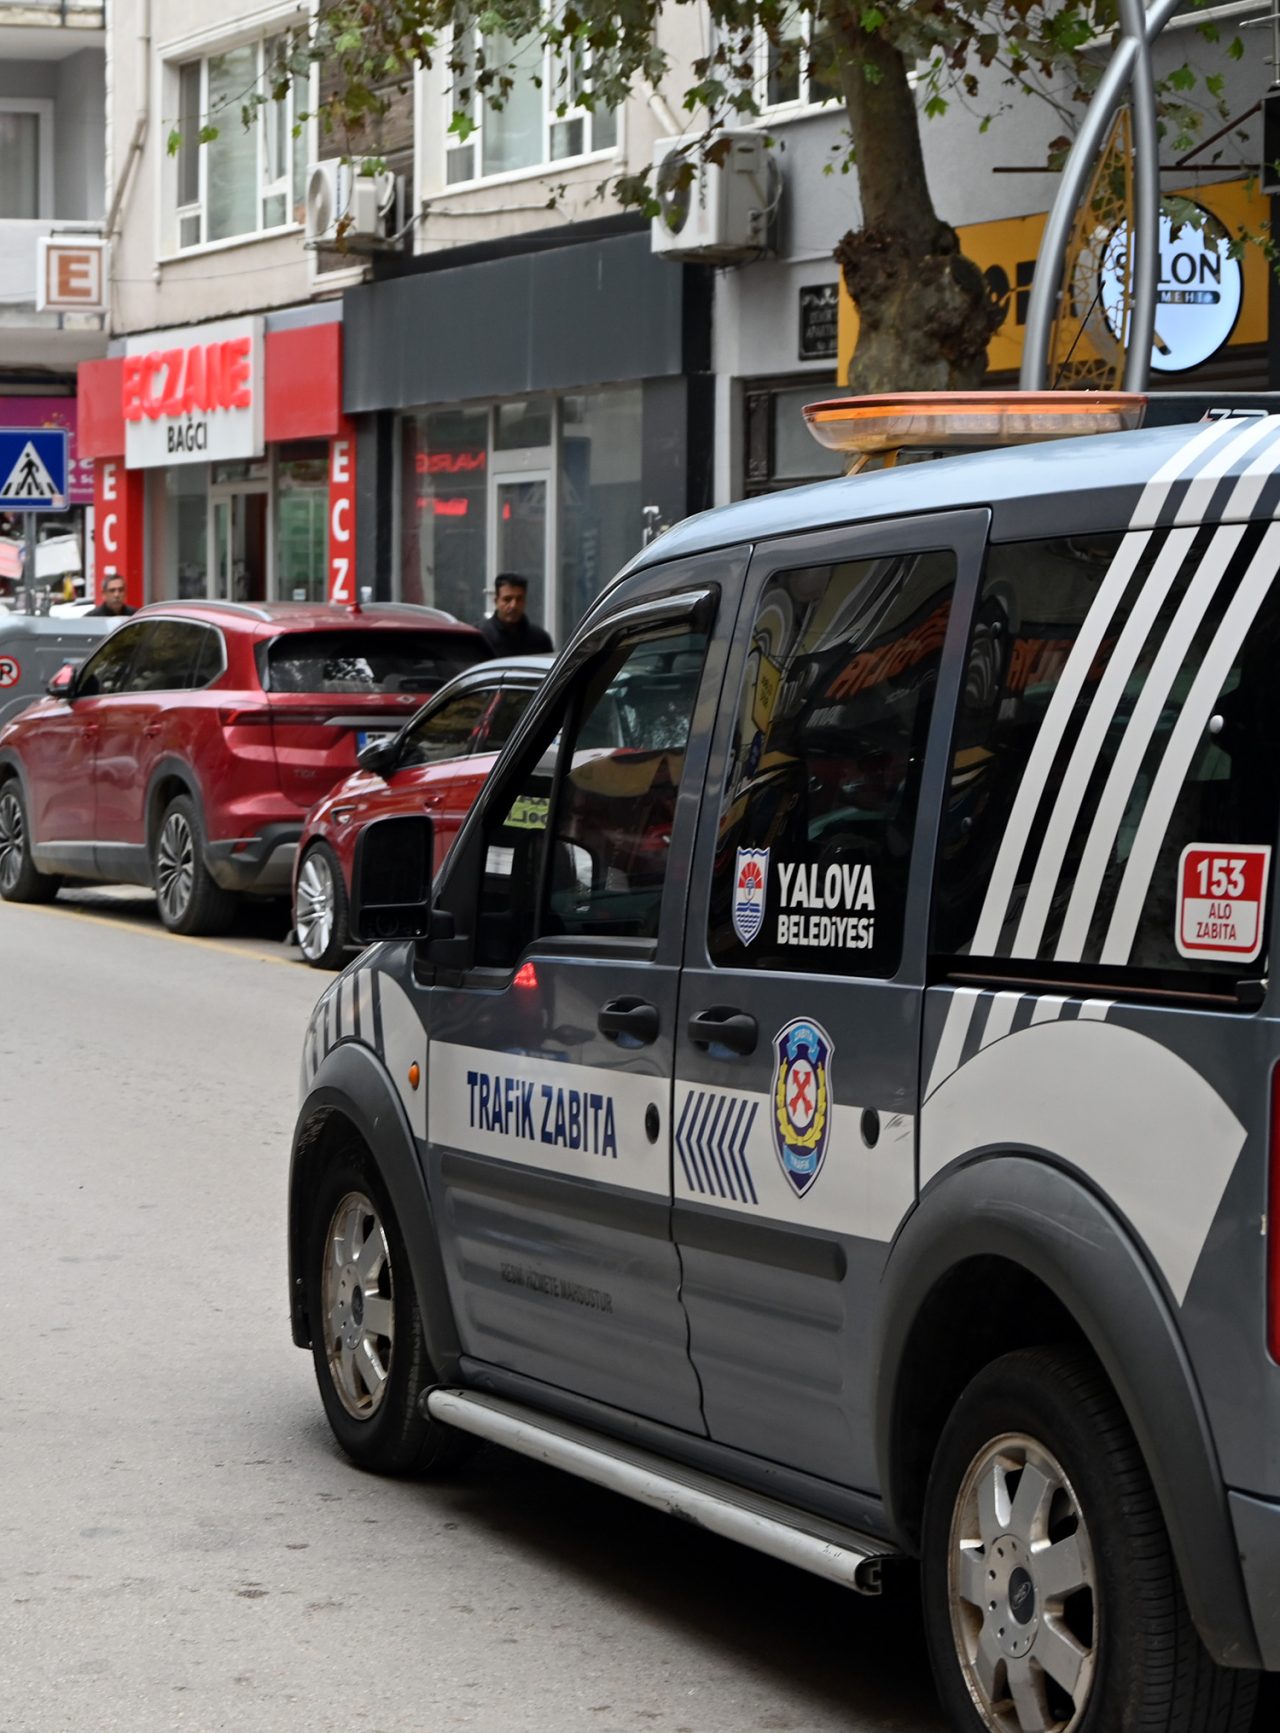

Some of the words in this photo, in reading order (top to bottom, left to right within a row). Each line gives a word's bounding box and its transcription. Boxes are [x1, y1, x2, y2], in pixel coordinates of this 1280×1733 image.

[60, 253, 94, 298] E
[122, 337, 252, 421] ECZANE
[167, 418, 208, 453] BAĞCI
[777, 863, 876, 912] YALOVA
[1196, 858, 1246, 898] 153
[1196, 922, 1238, 942] ZABITA
[1208, 902, 1233, 920] ALO
[540, 1084, 618, 1159] ZABITA
